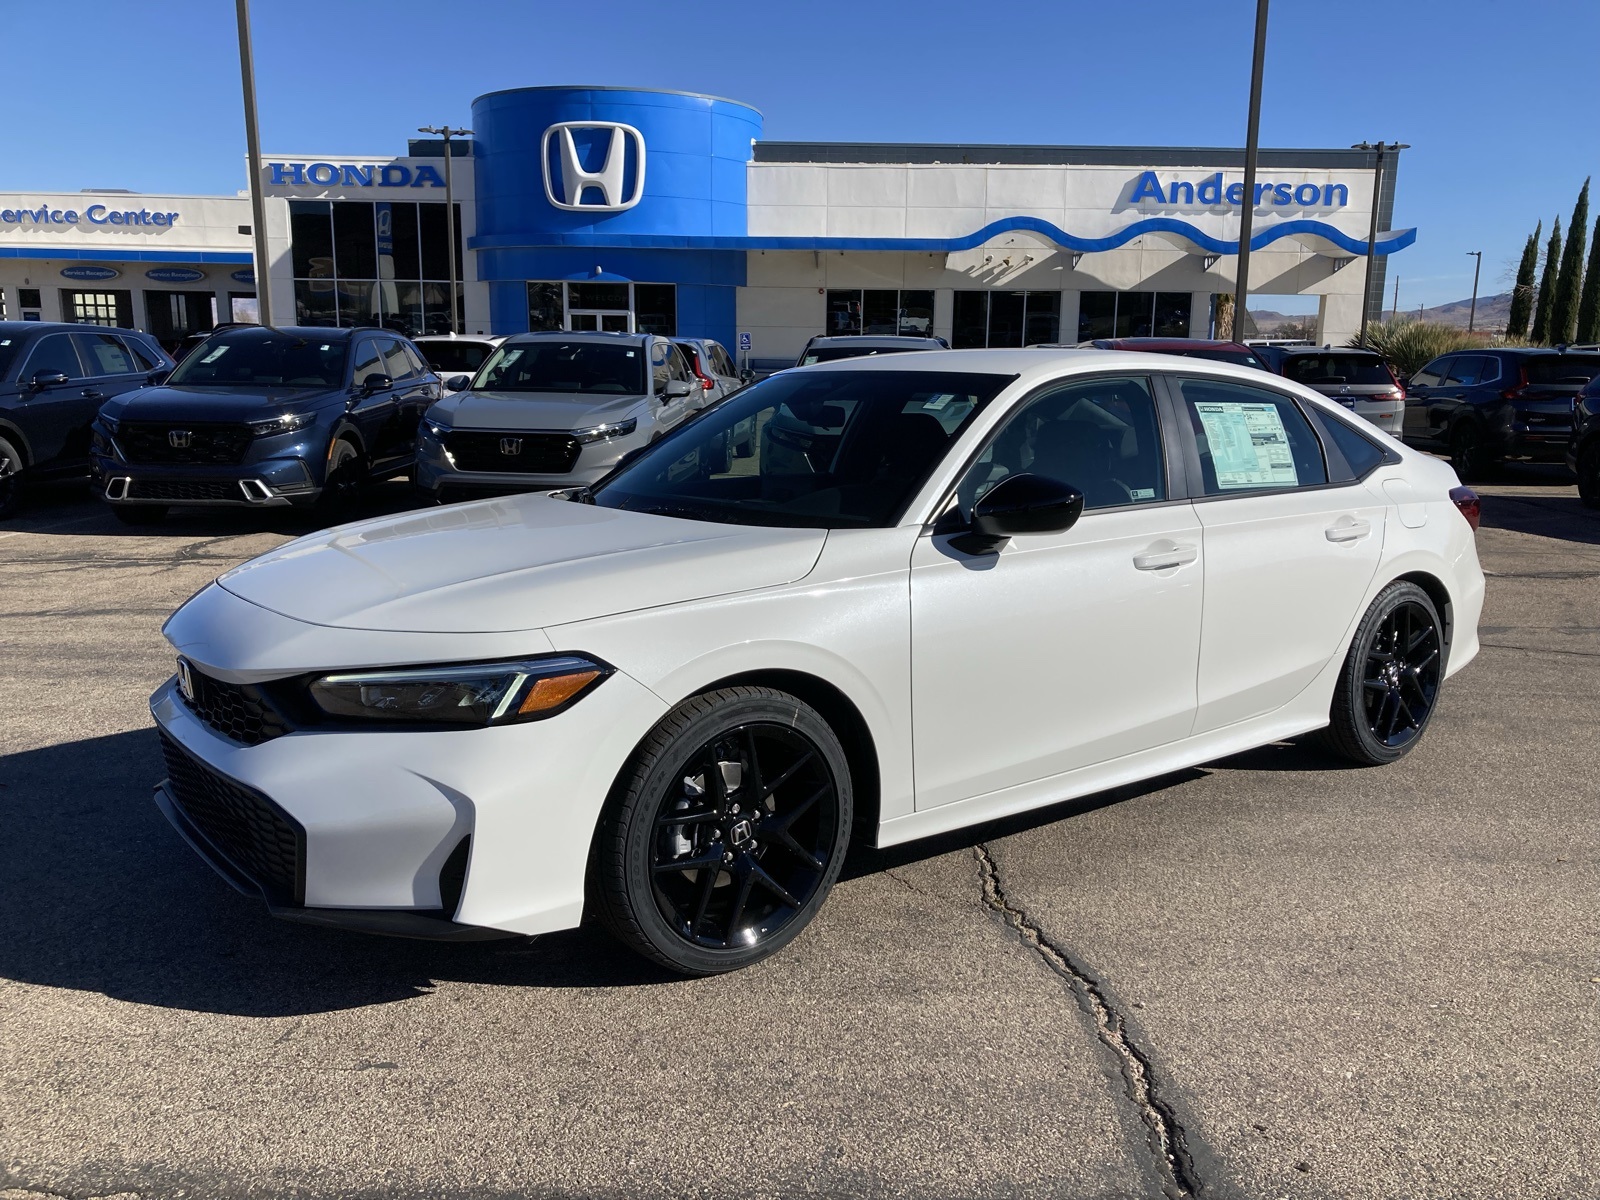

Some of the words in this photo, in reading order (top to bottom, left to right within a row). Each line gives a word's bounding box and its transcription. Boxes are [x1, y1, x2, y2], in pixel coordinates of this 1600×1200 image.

[268, 162, 447, 188] HONDA
[1130, 170, 1349, 207] Anderson
[0, 204, 79, 224] ervice
[86, 204, 180, 227] Center
[85, 270, 115, 279] Reception
[171, 271, 200, 279] Reception
[633, 769, 667, 891] GOODYEAR
